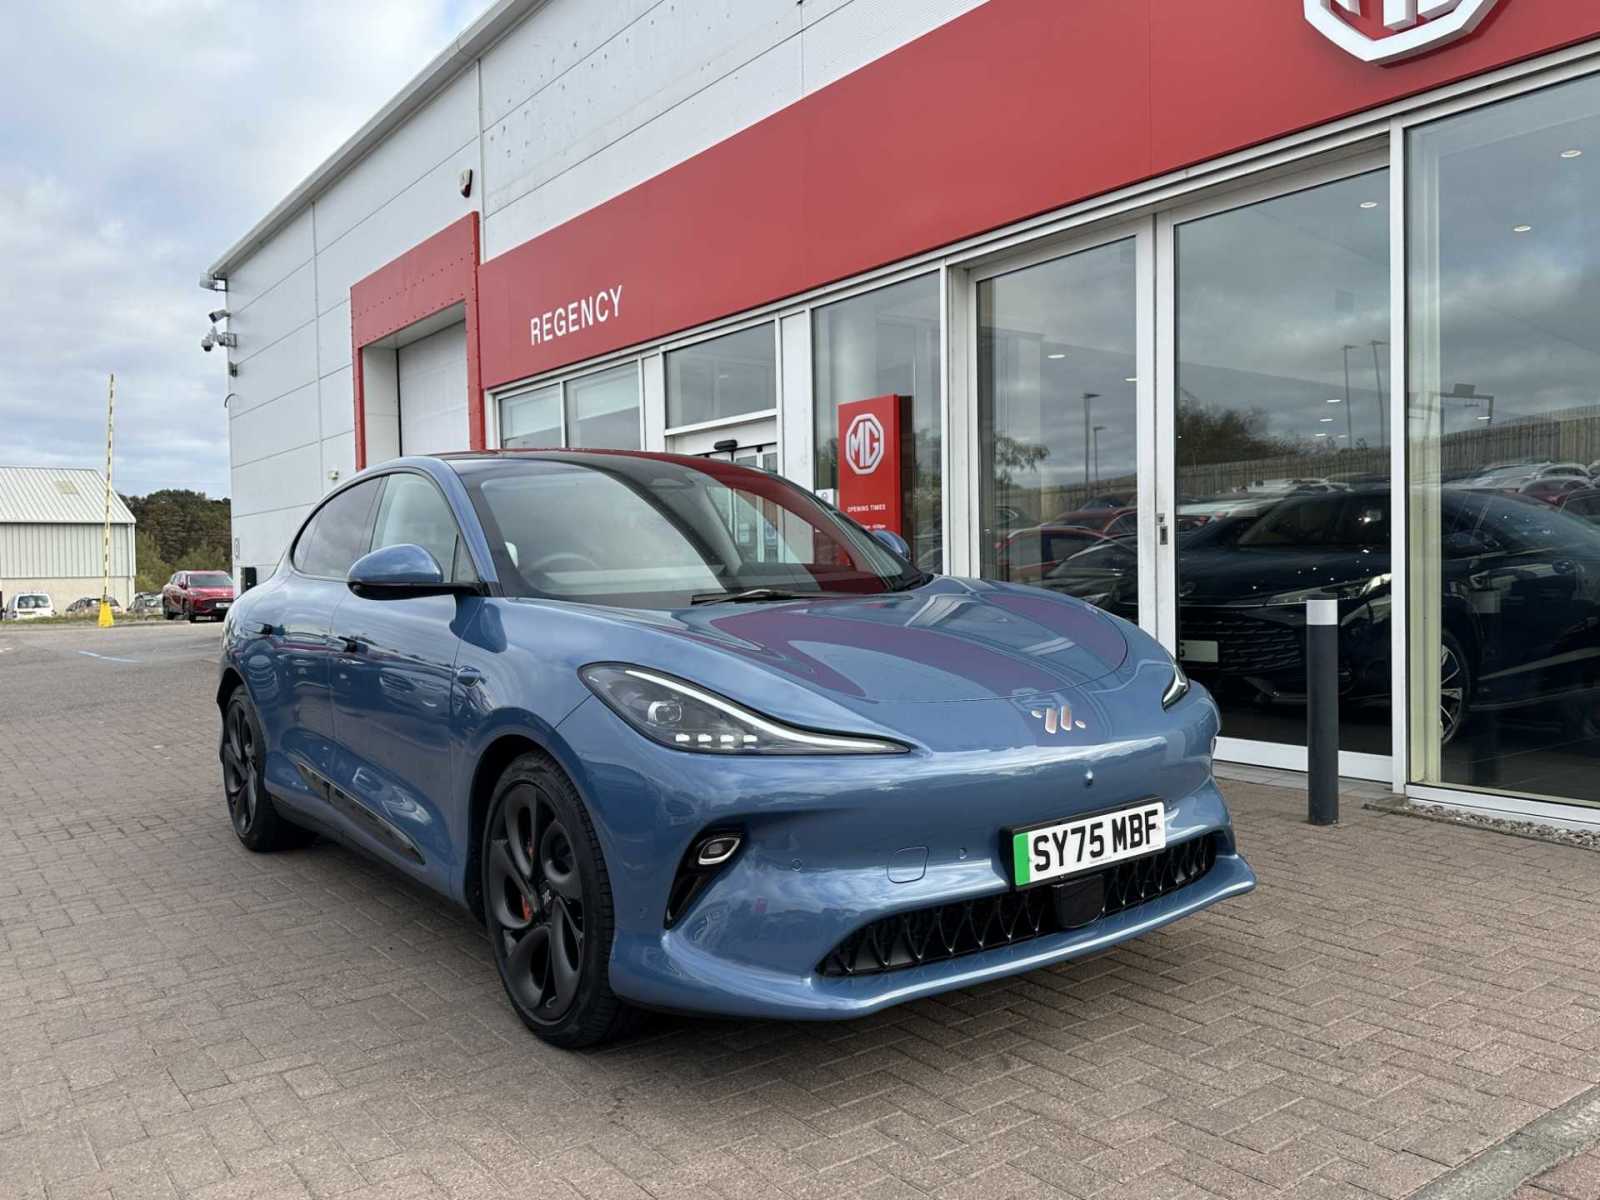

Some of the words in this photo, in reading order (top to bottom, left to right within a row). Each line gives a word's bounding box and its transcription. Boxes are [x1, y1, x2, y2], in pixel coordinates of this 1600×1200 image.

[530, 284, 622, 346] REGENCY
[849, 419, 881, 468] MG
[847, 505, 869, 513] OPENING
[870, 503, 886, 511] TIMES
[1033, 821, 1104, 872] SY75
[1111, 808, 1159, 853] MBF
